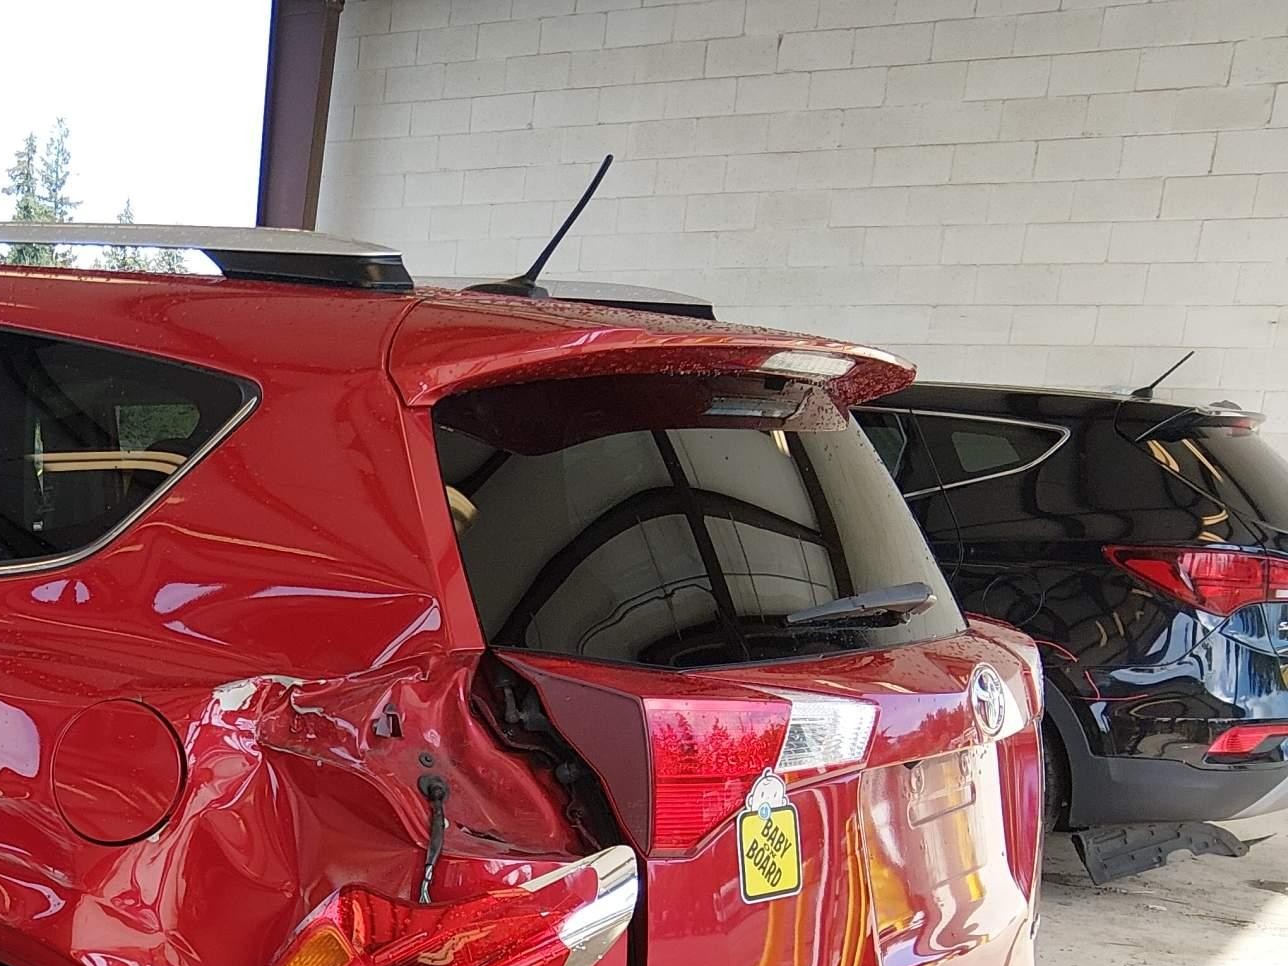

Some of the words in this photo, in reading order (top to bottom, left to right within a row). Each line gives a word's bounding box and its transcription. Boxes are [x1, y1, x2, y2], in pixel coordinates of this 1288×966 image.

[761, 819, 792, 858] BABY
[763, 843, 777, 859] ON
[746, 838, 782, 887] BOARD
